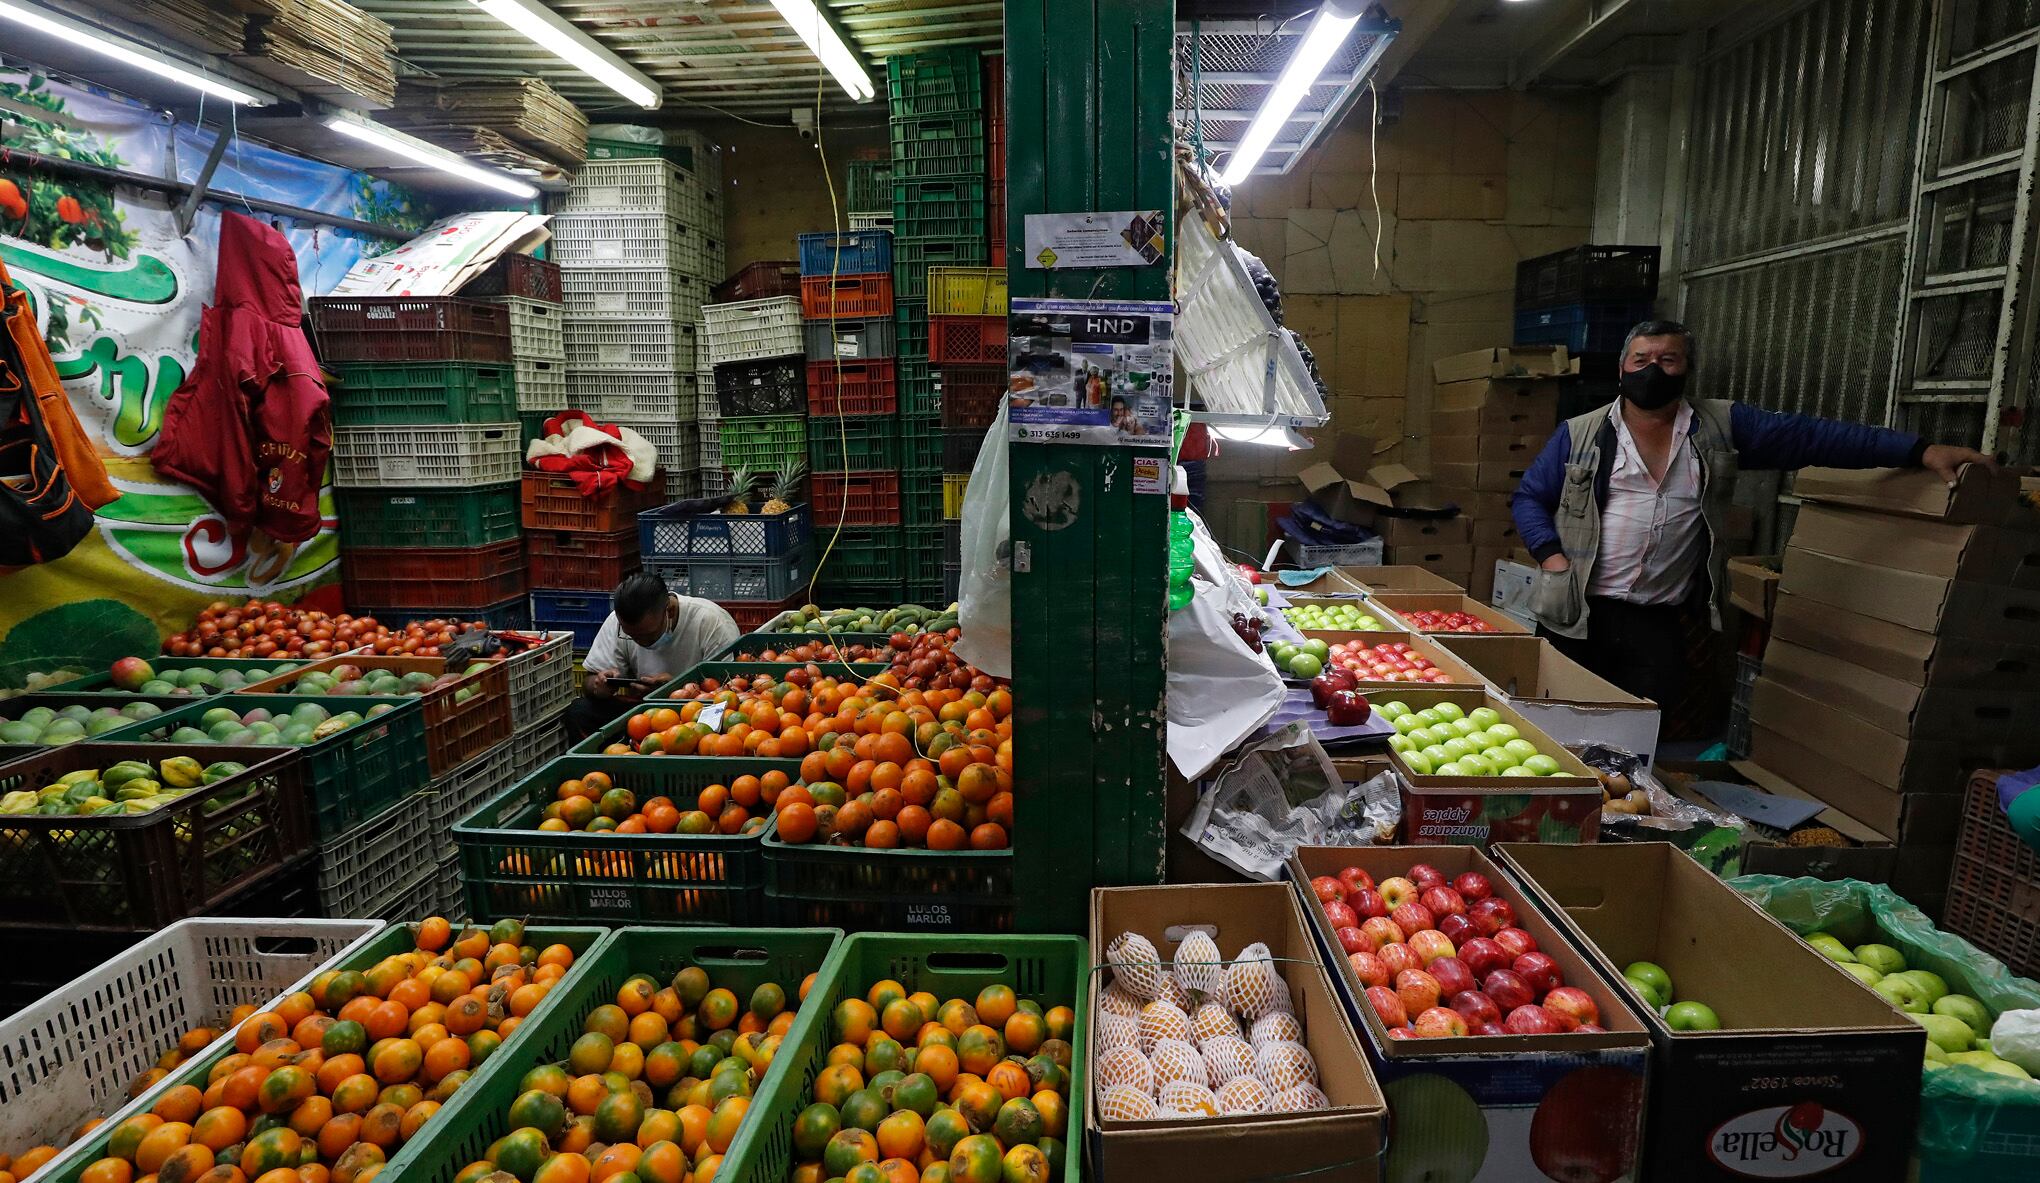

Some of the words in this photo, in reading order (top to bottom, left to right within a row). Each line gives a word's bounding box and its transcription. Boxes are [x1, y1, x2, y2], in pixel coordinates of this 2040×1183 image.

[1086, 318, 1135, 334] HND
[1030, 430, 1043, 438] 313
[1062, 431, 1081, 439] 1499
[1423, 808, 1470, 823] Apples
[1420, 825, 1489, 838] Manzanas
[590, 889, 628, 899] LULOS
[589, 898, 632, 908] MARLOR
[908, 905, 948, 914] LULOS
[906, 914, 952, 924] MARLOR
